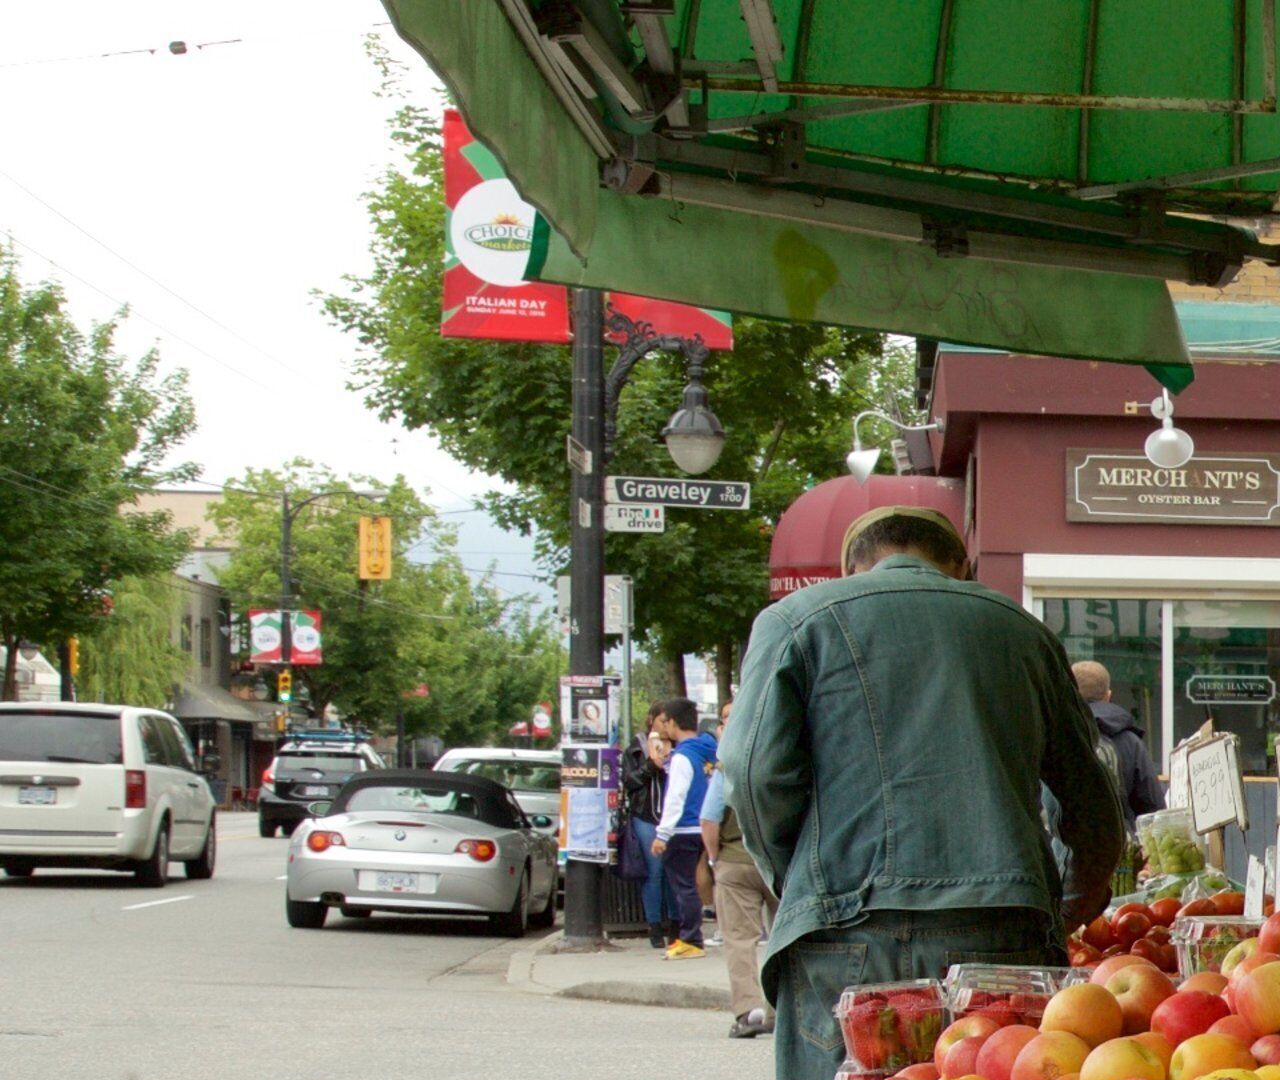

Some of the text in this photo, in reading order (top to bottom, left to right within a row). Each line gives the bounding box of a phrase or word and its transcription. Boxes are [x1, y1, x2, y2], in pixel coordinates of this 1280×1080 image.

[465, 297, 547, 309] ITALIAN DAY
[622, 480, 736, 505] Graveley St
[719, 493, 742, 503] 1700
[1137, 493, 1221, 506] OYSTER BAR
[627, 518, 663, 529] drive
